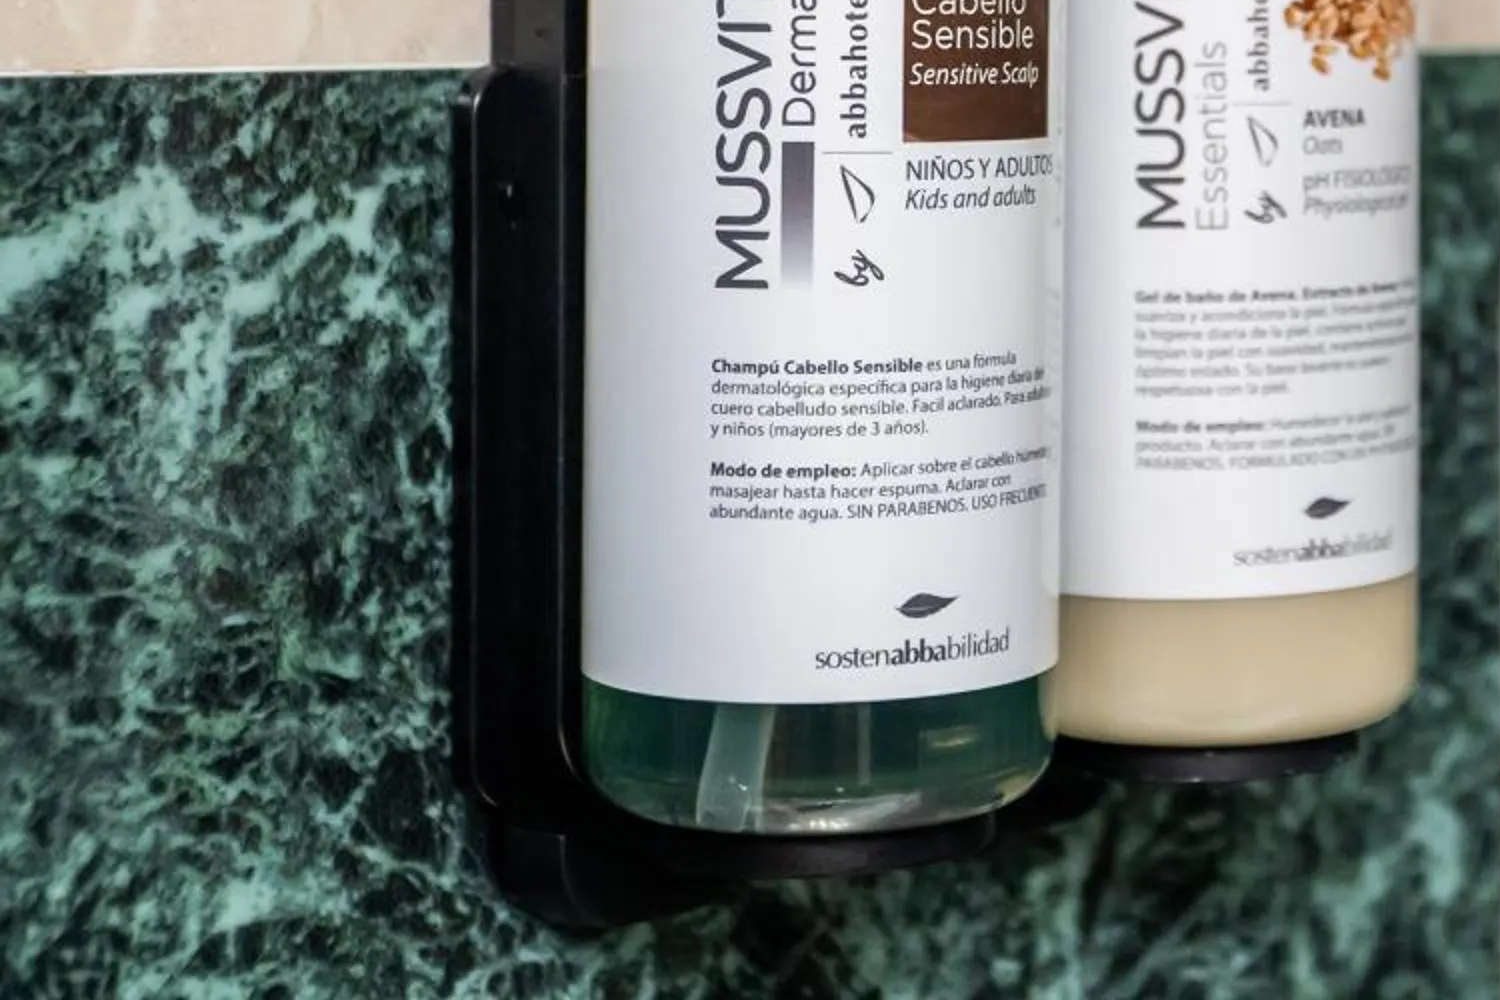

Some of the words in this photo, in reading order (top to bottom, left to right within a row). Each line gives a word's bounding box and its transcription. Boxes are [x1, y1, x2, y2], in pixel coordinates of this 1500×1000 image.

[911, 18, 1035, 50] Sensible
[909, 62, 999, 86] Sensitive
[1001, 60, 1040, 88] Scalp
[1302, 107, 1366, 129] AVENA
[1194, 41, 1228, 232] Essentials
[906, 155, 975, 181] NIÑOS
[979, 157, 991, 179] Y
[995, 153, 1054, 179] ADULTOS
[905, 187, 949, 210] Kids
[953, 186, 991, 208] and
[993, 183, 1037, 207] adults
[833, 249, 884, 287] by
[711, 359, 779, 377] Champú
[783, 360, 849, 375] Cabello
[853, 357, 923, 375] Sensible
[926, 359, 942, 371] es
[945, 357, 970, 371] una
[711, 379, 825, 399] dermatológica
[829, 379, 907, 398] específica
[911, 379, 943, 396] para
[946, 377, 958, 391] la
[961, 374, 1005, 393] higiene
[711, 402, 753, 416] cuero
[757, 401, 837, 417] cabelludo
[841, 400, 909, 416] sensible.
[709, 423, 720, 439] y
[723, 421, 765, 437] niños
[769, 421, 842, 440] (mayores
[846, 421, 867, 437] de
[870, 421, 881, 436] 3
[884, 418, 929, 436] años).
[710, 461, 757, 478] Modo
[761, 462, 782, 478] de
[786, 462, 857, 481] empleo:
[860, 461, 914, 480] Aplicar
[917, 458, 957, 475] sobre
[960, 456, 973, 471] el
[975, 451, 1014, 470] cabello
[709, 484, 779, 502] masajear
[783, 484, 826, 499] hasta
[830, 484, 875, 499] hacer
[879, 482, 940, 500] espuma.
[945, 476, 989, 493] Aclarar
[991, 474, 1012, 489] con
[709, 503, 795, 520] abundante
[798, 506, 843, 525] agua.
[847, 503, 873, 519] SIN
[877, 497, 969, 519] PARABENOS.
[971, 493, 998, 511] USO
[815, 626, 1010, 670] sostenabbabilidad
